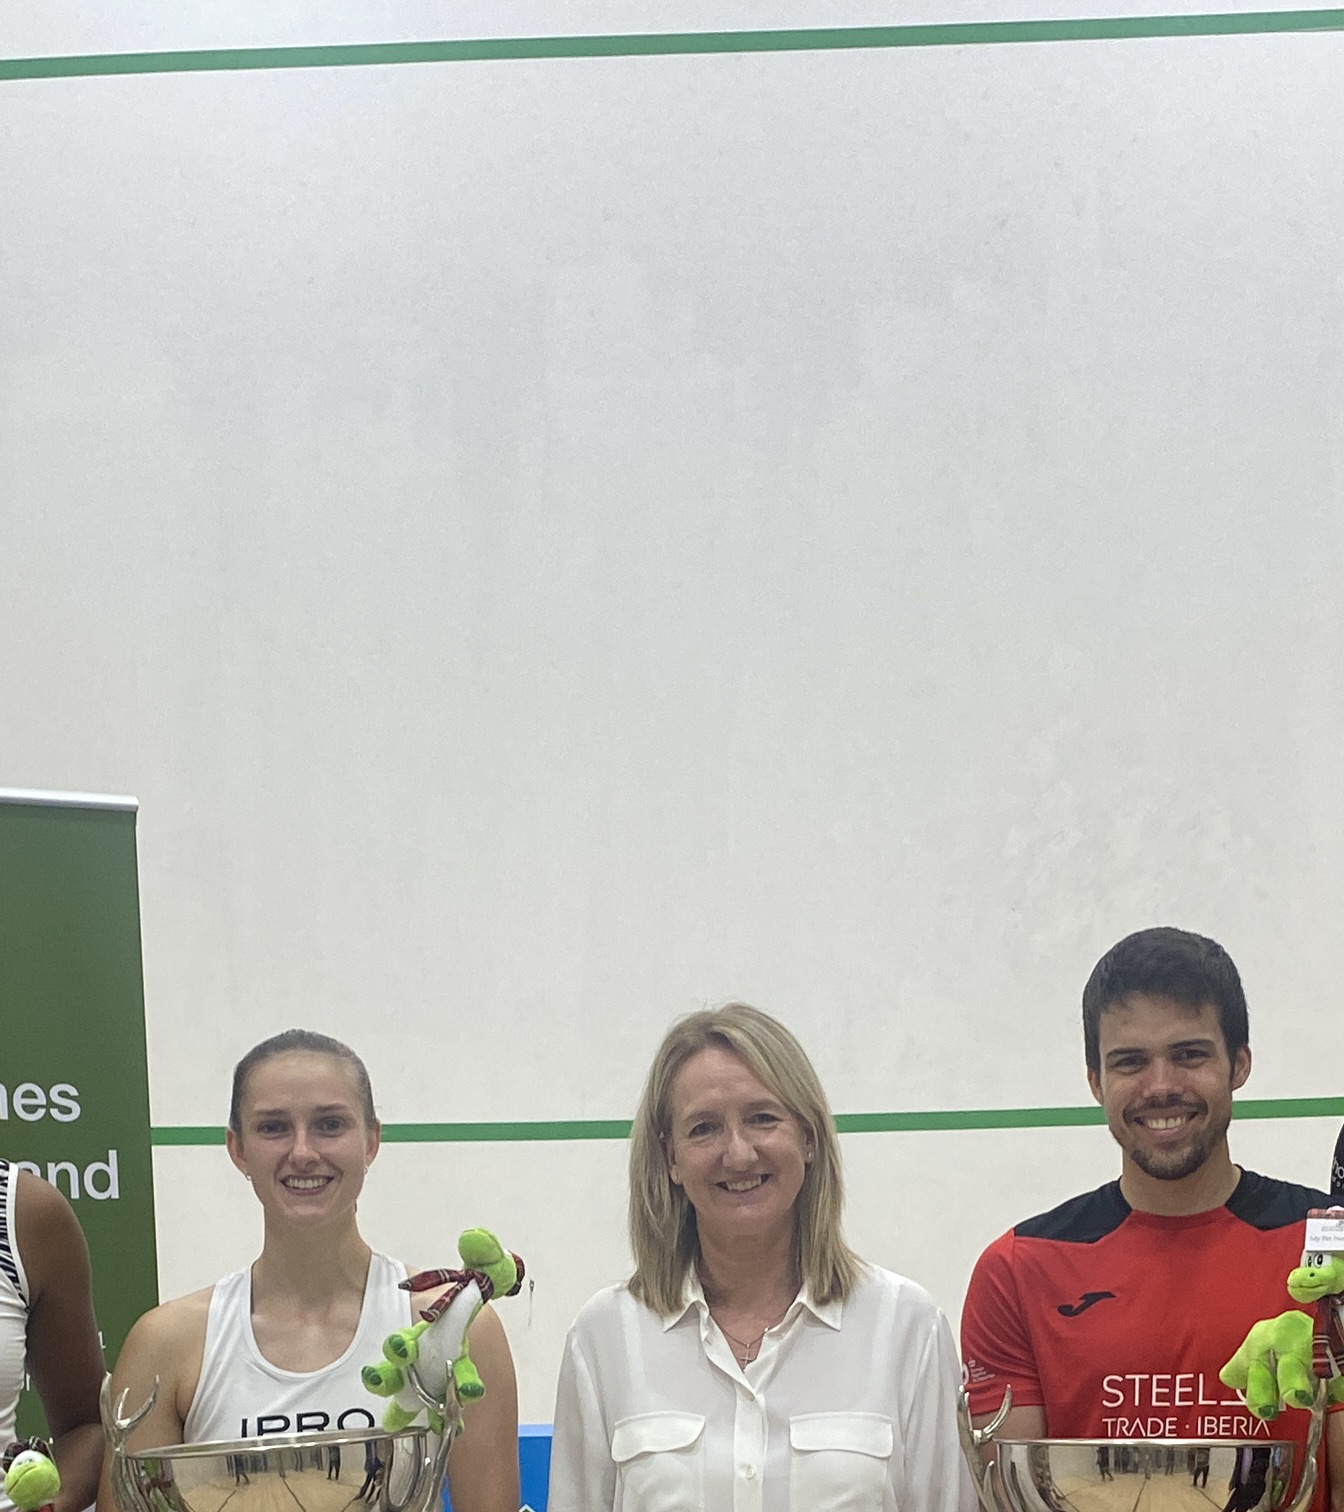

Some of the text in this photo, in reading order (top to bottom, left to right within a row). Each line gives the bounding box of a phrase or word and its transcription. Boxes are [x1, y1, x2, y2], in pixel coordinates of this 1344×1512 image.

[1102, 1373, 1217, 1408] STEEL
[1102, 1416, 1271, 1438] TRADE IBERIA
